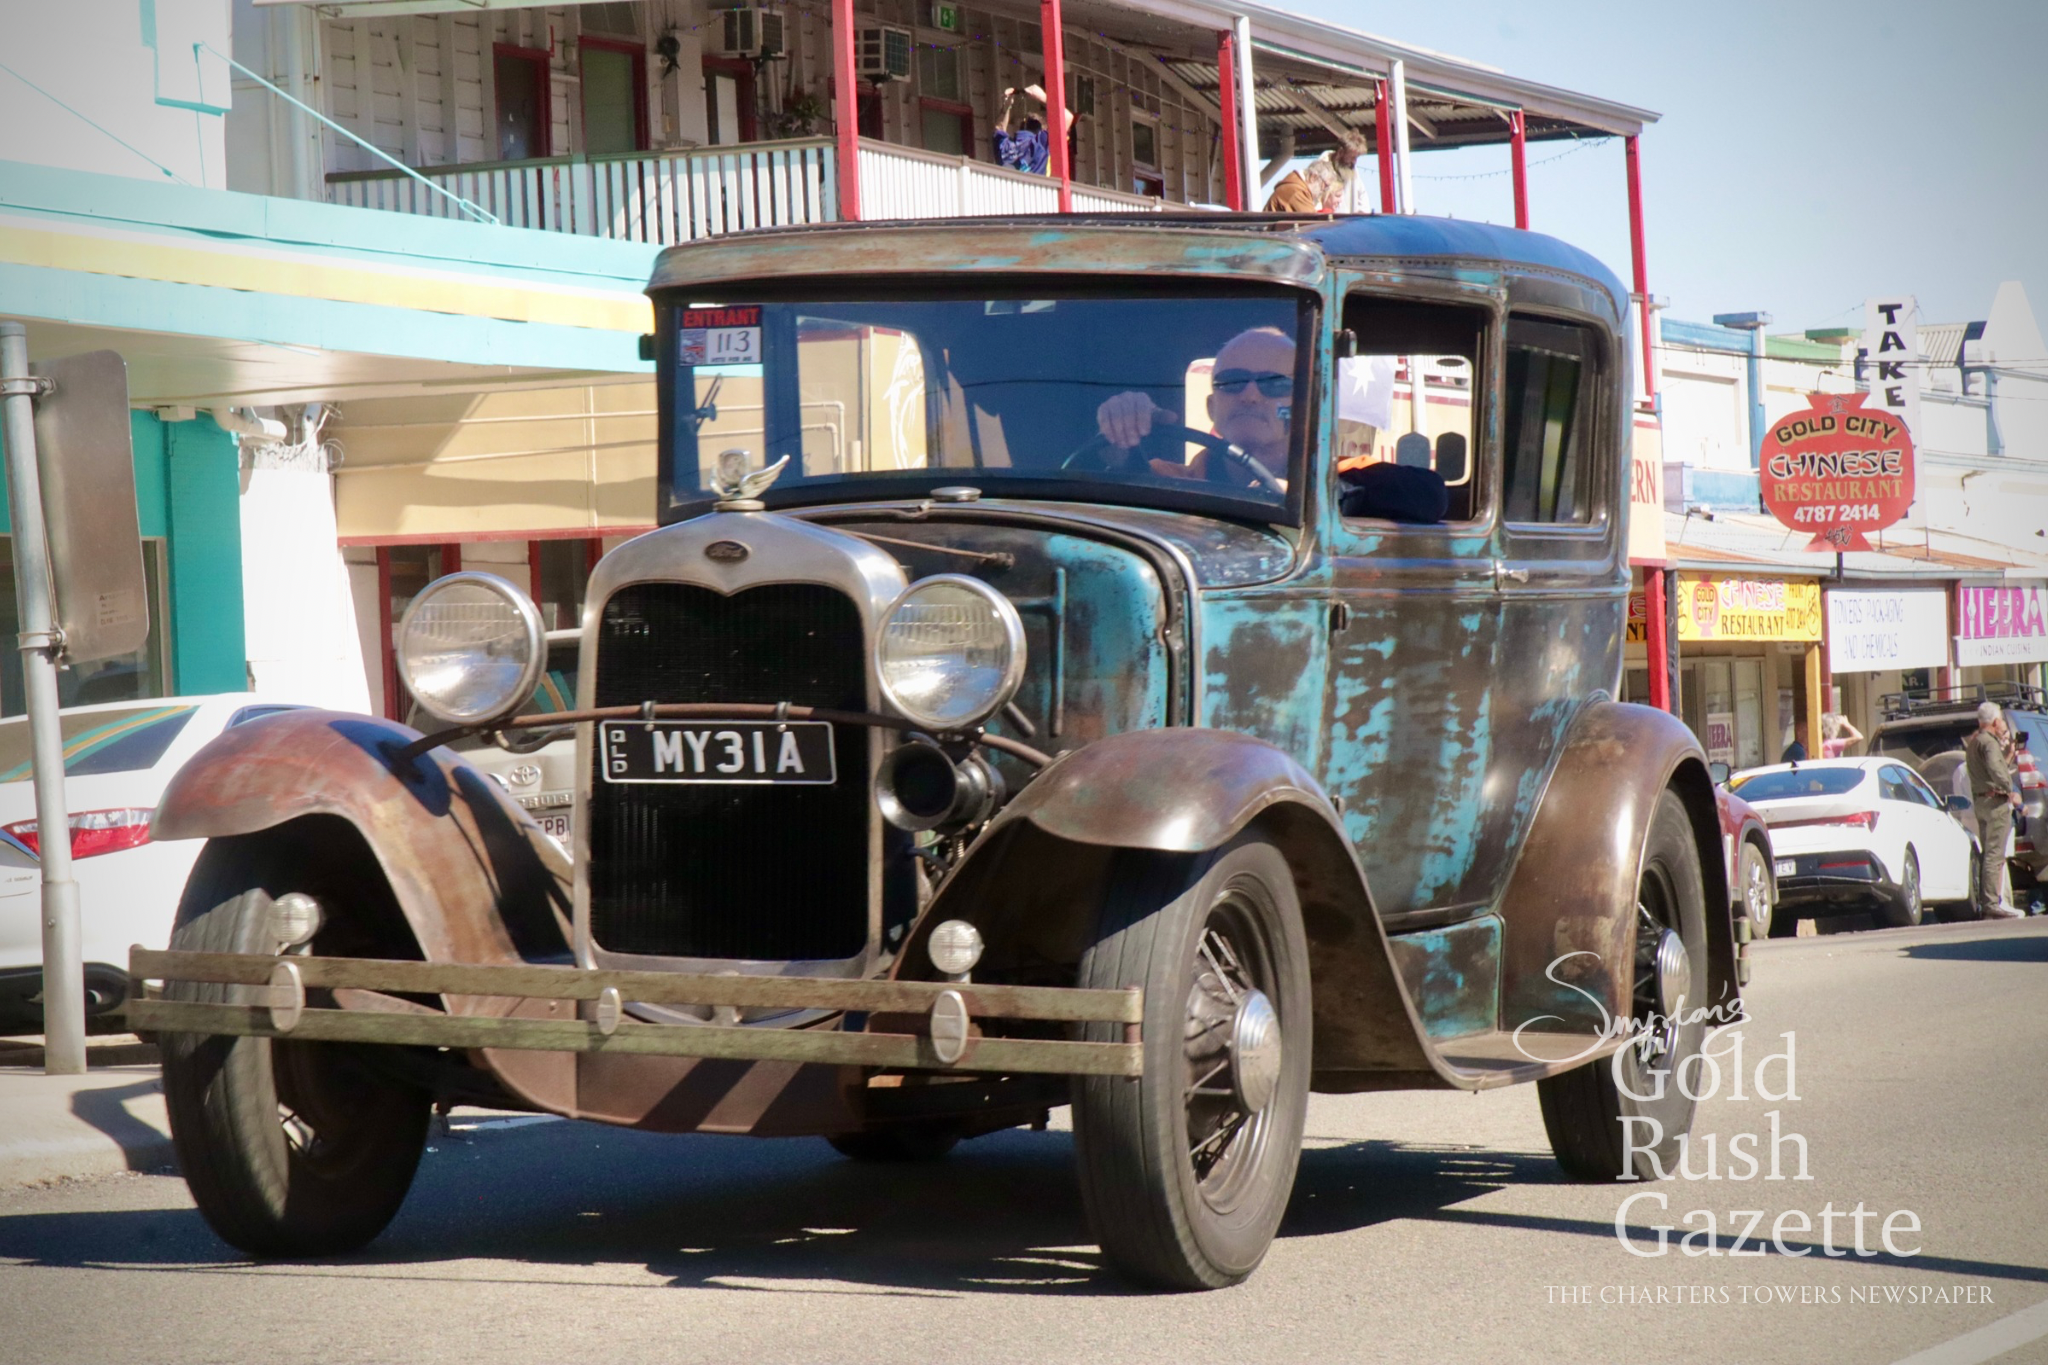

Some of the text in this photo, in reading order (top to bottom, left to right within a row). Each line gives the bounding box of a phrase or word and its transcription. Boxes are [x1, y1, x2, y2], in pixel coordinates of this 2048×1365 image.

[683, 307, 760, 328] ENTRANT
[716, 330, 751, 354] 113
[1776, 416, 1899, 446] GOLD CITY
[1768, 449, 1903, 480] CHINESE
[1774, 480, 1903, 502] RESTAURANT
[1794, 504, 1880, 523] 4787 2414
[1696, 588, 1715, 602] GOLD
[1720, 577, 1785, 611] CHINESE
[1697, 607, 1714, 621] CITY
[1962, 586, 2046, 640] HEERA
[1721, 615, 1785, 635] RESTAURANT
[1980, 643, 2031, 657] INDIAN CUISINE
[610, 729, 628, 773] QLD
[652, 730, 805, 773] MY31A
